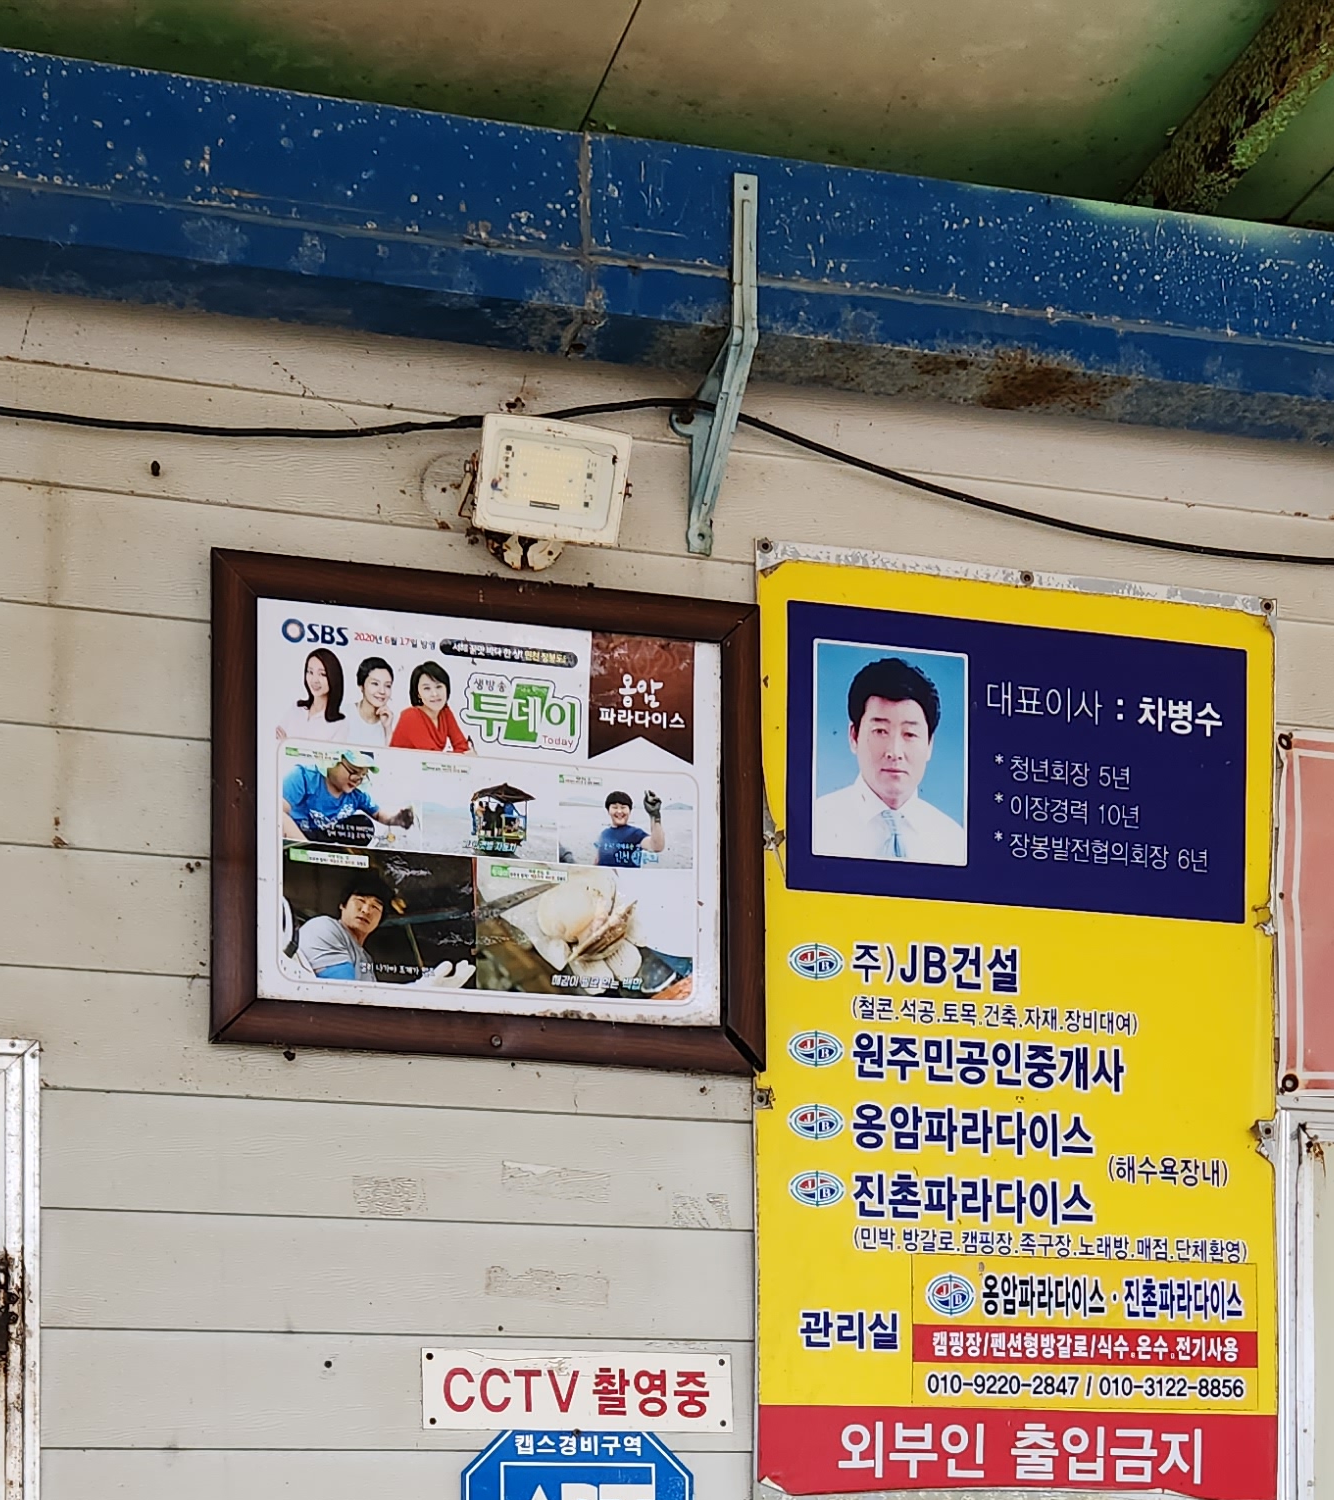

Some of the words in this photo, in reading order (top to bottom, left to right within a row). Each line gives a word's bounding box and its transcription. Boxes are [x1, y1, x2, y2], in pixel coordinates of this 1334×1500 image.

[307, 622, 349, 646] SBS
[354, 632, 383, 645] 2020년
[384, 635, 397, 646] 6월
[473, 677, 507, 693] 생방송
[618, 673, 664, 709] 옹암
[467, 689, 576, 738] 투데이
[598, 707, 686, 730] 파라다이스
[986, 681, 1103, 726] 대표이사
[1137, 696, 1223, 737] 차병수
[542, 735, 574, 749] Today
[1009, 755, 1090, 788] 청년회장
[1098, 765, 1131, 790] 5년
[1010, 794, 1089, 826] 이장경력
[1098, 803, 1140, 829] 10년
[1009, 832, 1169, 870] 장봉발전협의회장
[1178, 848, 1209, 873] 6년
[851, 943, 1019, 994] 주)JB건설
[851, 996, 1139, 1036] (철콘.석공.토목.건축.자재.장비대여)
[852, 1032, 1125, 1092] 원주민공인중개사
[852, 1104, 1094, 1157] 옹암파라다이스
[1107, 1154, 1229, 1188] (해수욕장내)
[852, 1171, 1094, 1224] 진촌파라다이스
[981, 1275, 1105, 1317] 옹암파라다이스
[1124, 1277, 1243, 1320] 진촌파라다이스
[799, 1310, 899, 1351] 관리실
[443, 1367, 580, 1413] CCTV
[592, 1367, 710, 1418] 촬영중
[927, 1374, 1079, 1397] 010-9220-2847
[1098, 1376, 1245, 1398] 010-3122-8856
[514, 1432, 642, 1457] 캡스경비구역
[837, 1421, 985, 1479] 외부인
[1010, 1422, 1203, 1485] 출입금지
